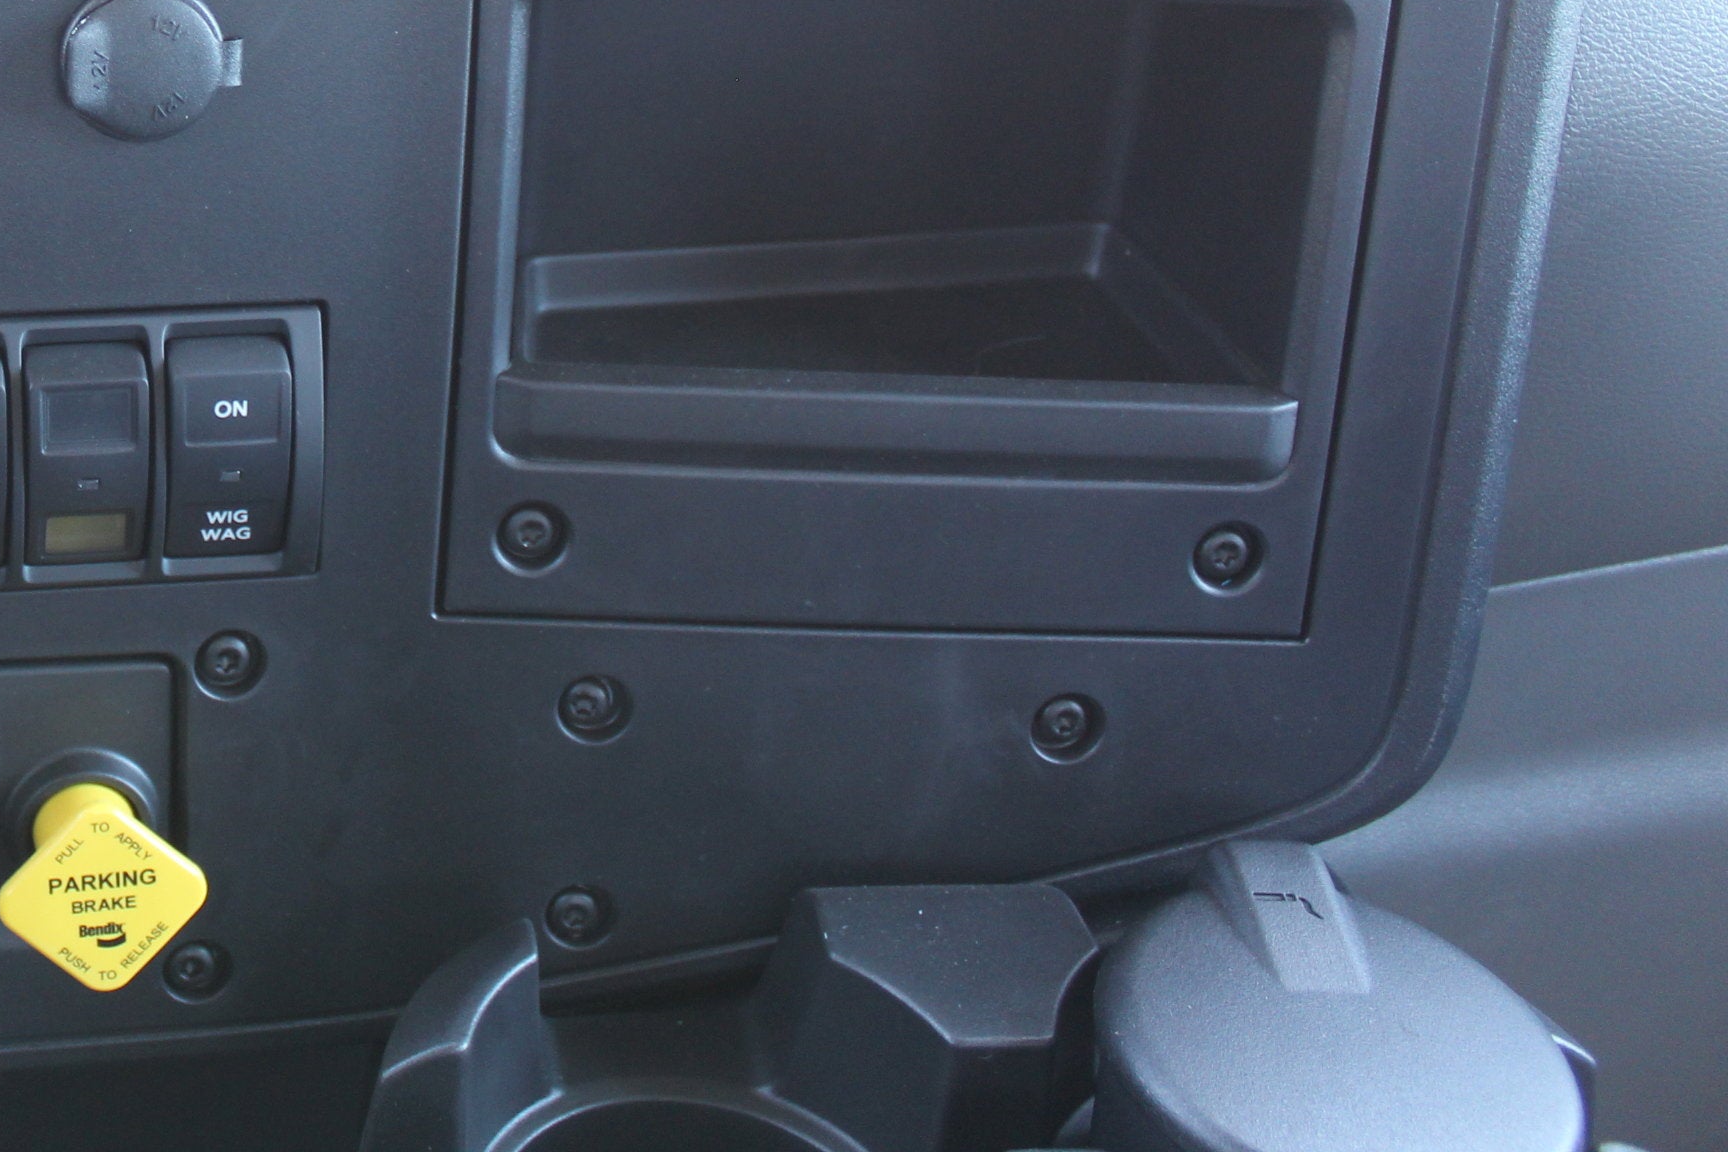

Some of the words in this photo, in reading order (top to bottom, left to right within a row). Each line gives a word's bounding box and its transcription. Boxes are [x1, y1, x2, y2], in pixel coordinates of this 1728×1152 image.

[214, 400, 249, 419] ON
[205, 509, 249, 524] WIG
[200, 526, 252, 542] WAG
[55, 837, 85, 865] PULL
[91, 821, 110, 833] TO
[114, 832, 153, 861] APPLY
[48, 868, 157, 895] PARKING
[71, 895, 137, 915] BRAKE
[78, 921, 124, 939] Bendix
[58, 946, 91, 973] PUSH
[98, 969, 118, 981] TO
[120, 920, 170, 970] RELEASE
